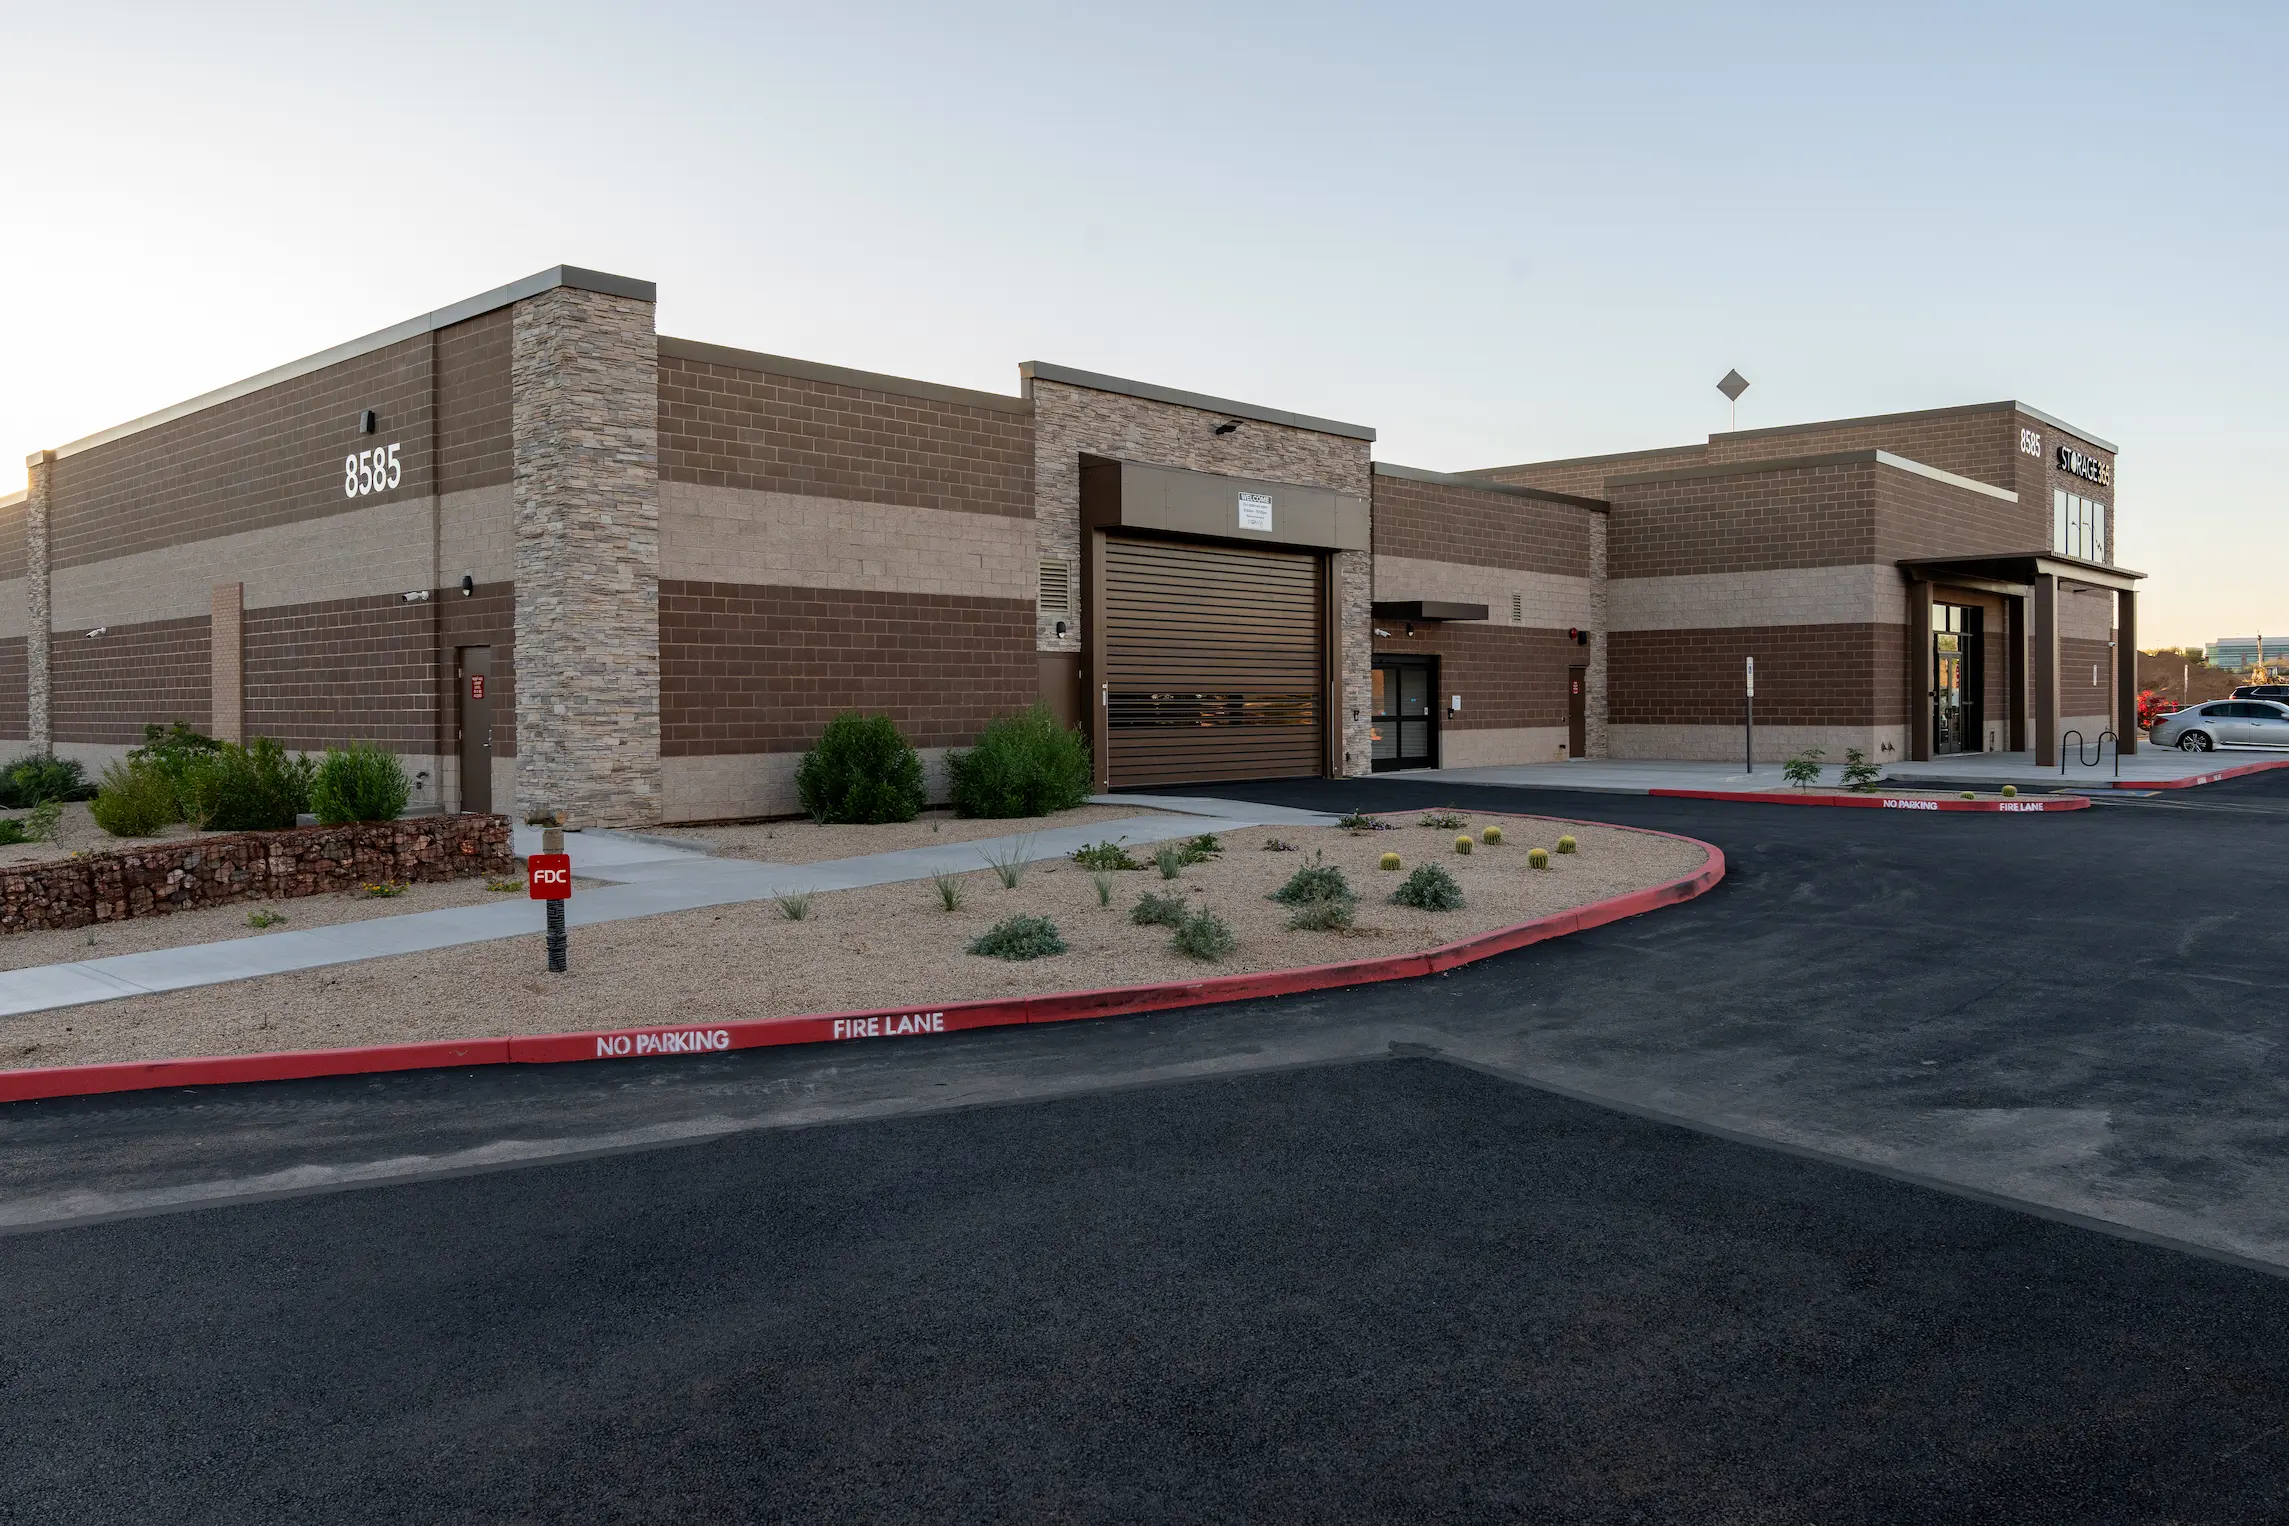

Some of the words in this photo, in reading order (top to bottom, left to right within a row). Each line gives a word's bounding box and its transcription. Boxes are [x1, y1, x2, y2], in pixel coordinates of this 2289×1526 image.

[2021, 428, 2041, 458] 8585
[344, 442, 401, 498] 8585
[1241, 493, 1271, 504] WELCOME
[1883, 800, 1897, 809] NO
[1898, 800, 1938, 810] PARKING
[2000, 802, 2019, 812] FIRE
[2020, 802, 2043, 811] LANE
[534, 869, 567, 884] FDC
[833, 1017, 880, 1039] FIRE
[885, 1012, 945, 1035] LANE
[596, 1035, 631, 1057] NO
[635, 1030, 730, 1054] PARKING
